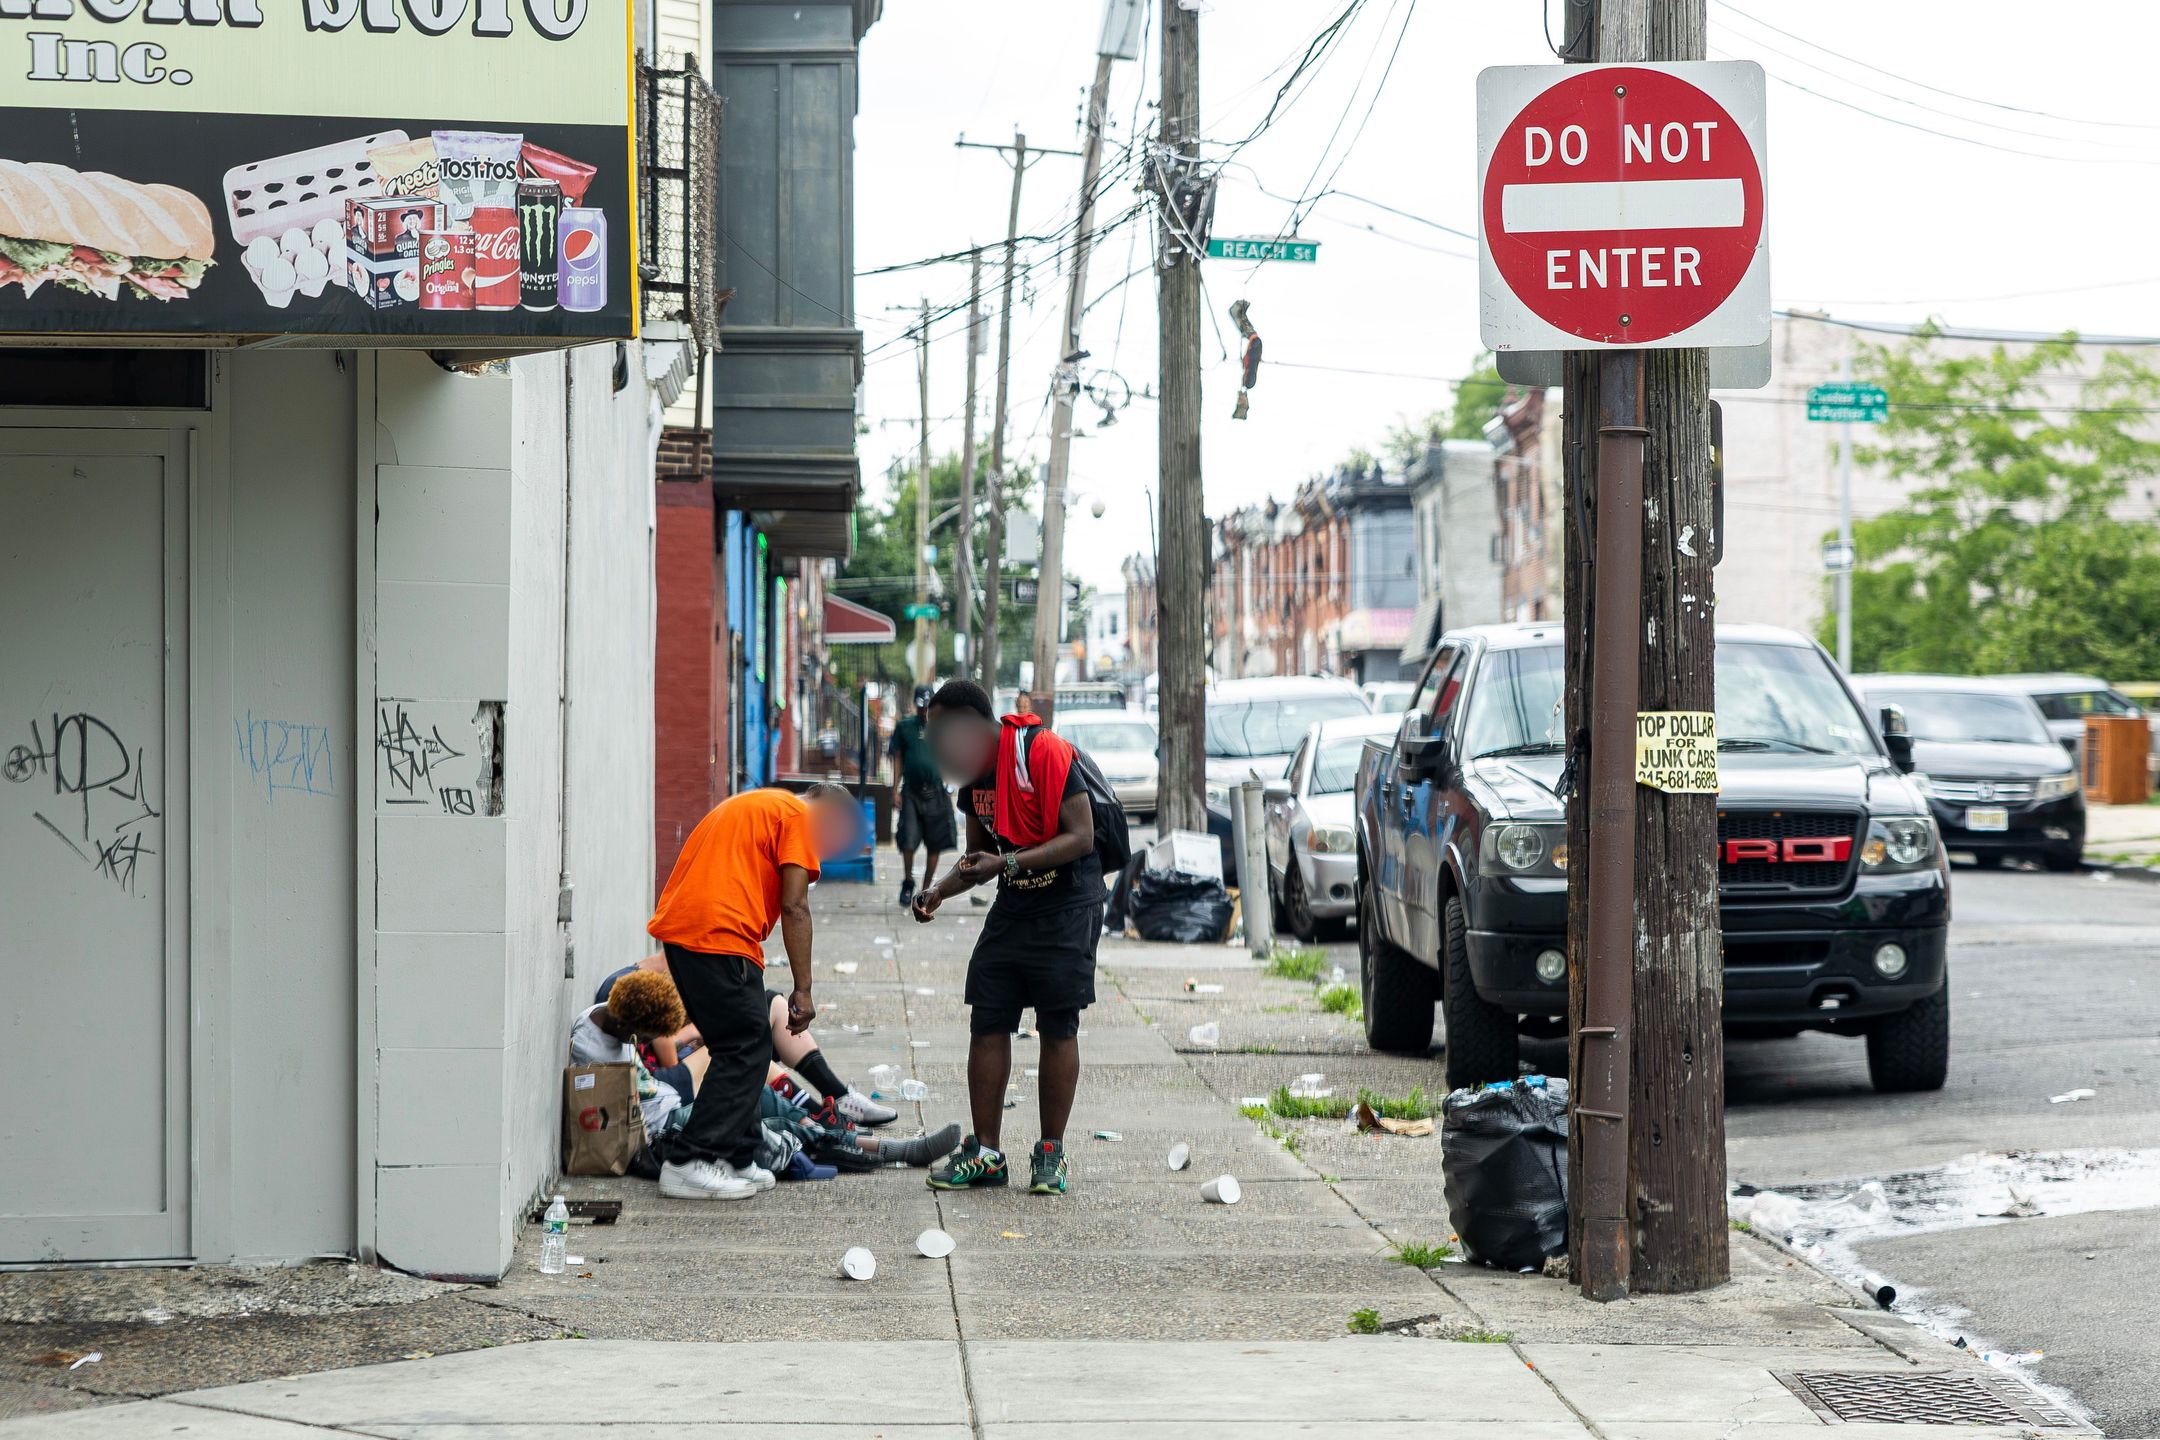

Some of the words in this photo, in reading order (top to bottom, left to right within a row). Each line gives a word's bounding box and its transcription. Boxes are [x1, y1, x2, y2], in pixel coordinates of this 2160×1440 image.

[27, 32, 193, 85] Inc.
[1525, 124, 1588, 166] DO
[1623, 121, 1718, 163] NOT
[385, 163, 439, 196] Cheeto
[396, 241, 419, 253] QUAK
[1222, 241, 1288, 259] REACH
[1293, 246, 1312, 260] St
[423, 259, 454, 281] Pringles
[1546, 246, 1702, 290] ENTER
[426, 282, 460, 294] Original
[567, 273, 598, 287] pepsi
[1637, 715, 1666, 737] TOP
[1670, 715, 1714, 738] DOLLAR
[1666, 738, 1696, 748] FOR
[1640, 749, 1684, 768] JUNK
[1687, 749, 1716, 769] CARS
[1717, 835, 1853, 863] RD
